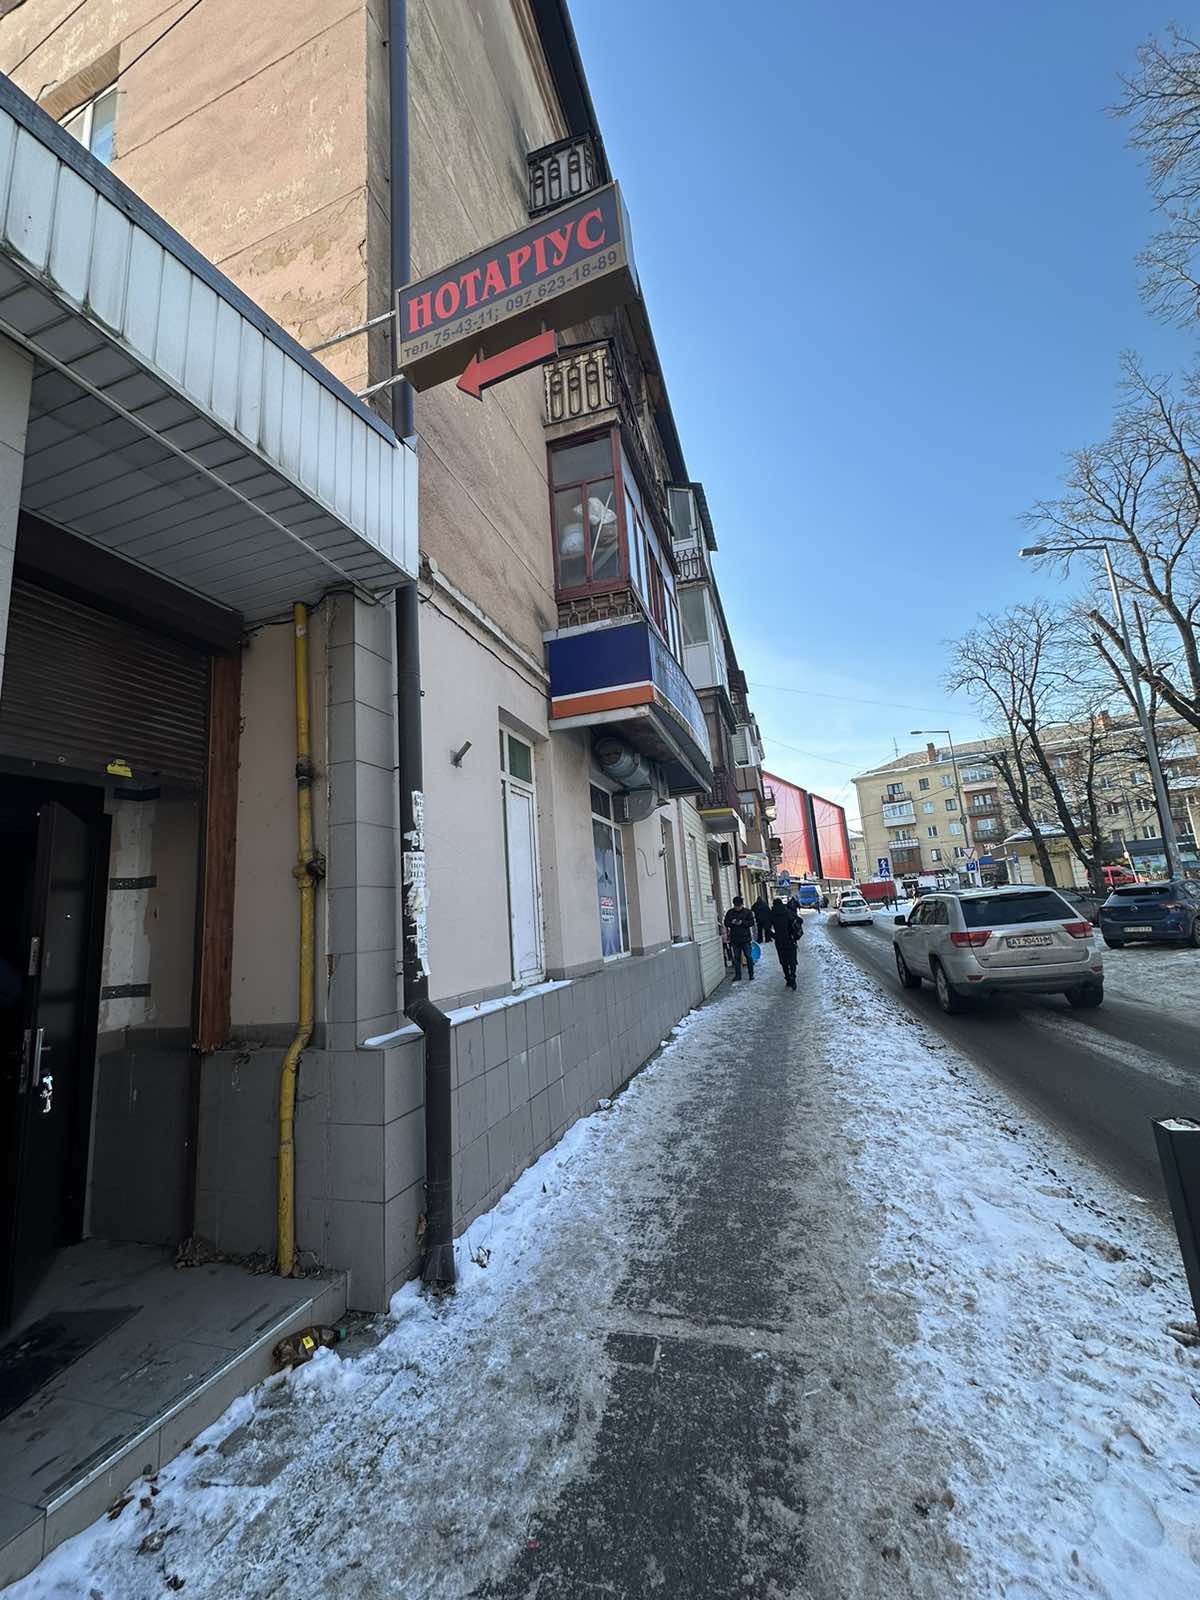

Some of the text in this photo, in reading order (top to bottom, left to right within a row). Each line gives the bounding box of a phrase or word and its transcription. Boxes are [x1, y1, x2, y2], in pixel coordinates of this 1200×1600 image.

[408, 207, 606, 334] НОТАРІУС
[505, 289, 533, 313] 097
[537, 250, 618, 298] 623-18-89
